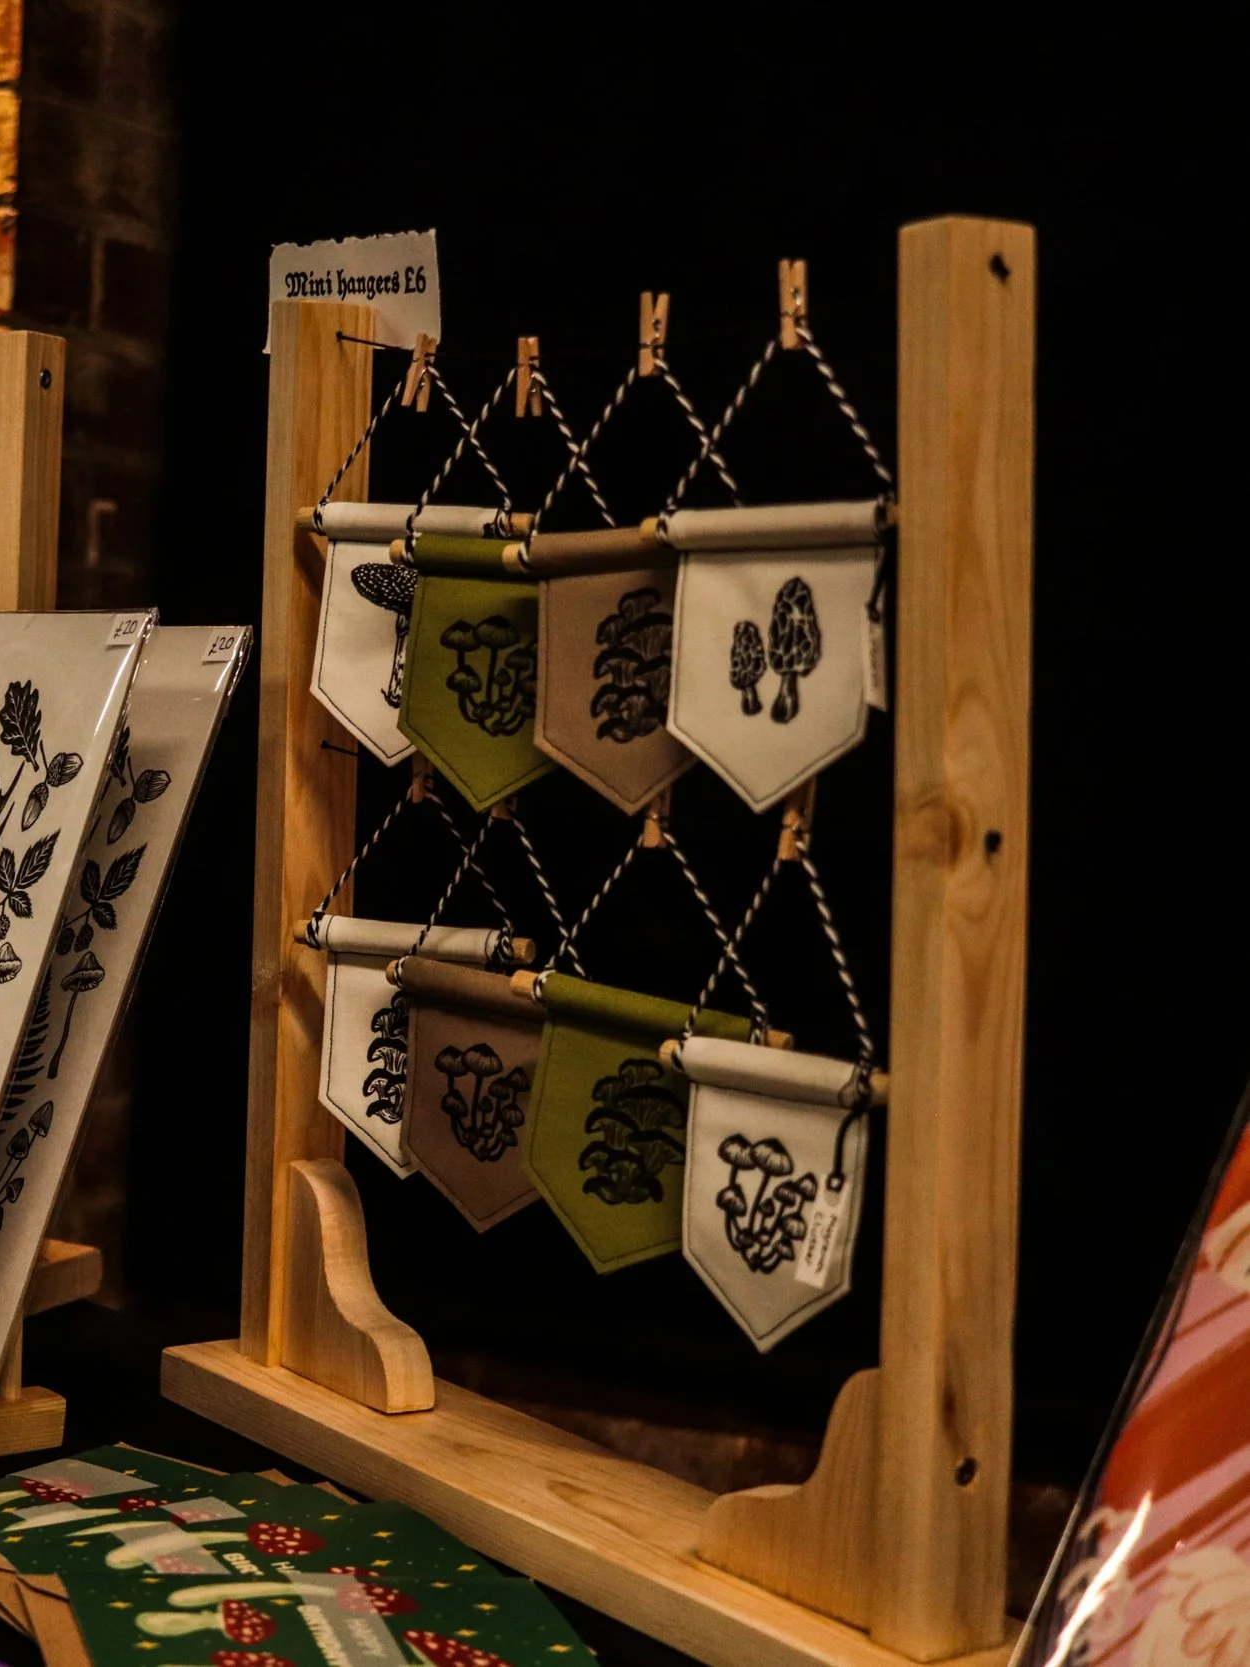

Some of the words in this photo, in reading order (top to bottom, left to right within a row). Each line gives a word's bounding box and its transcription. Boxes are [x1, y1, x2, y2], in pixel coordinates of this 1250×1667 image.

[285, 270, 333, 298] Mini
[336, 269, 400, 301] hangers
[404, 265, 426, 294] £6
[114, 619, 138, 639] £20
[208, 635, 235, 656] £20
